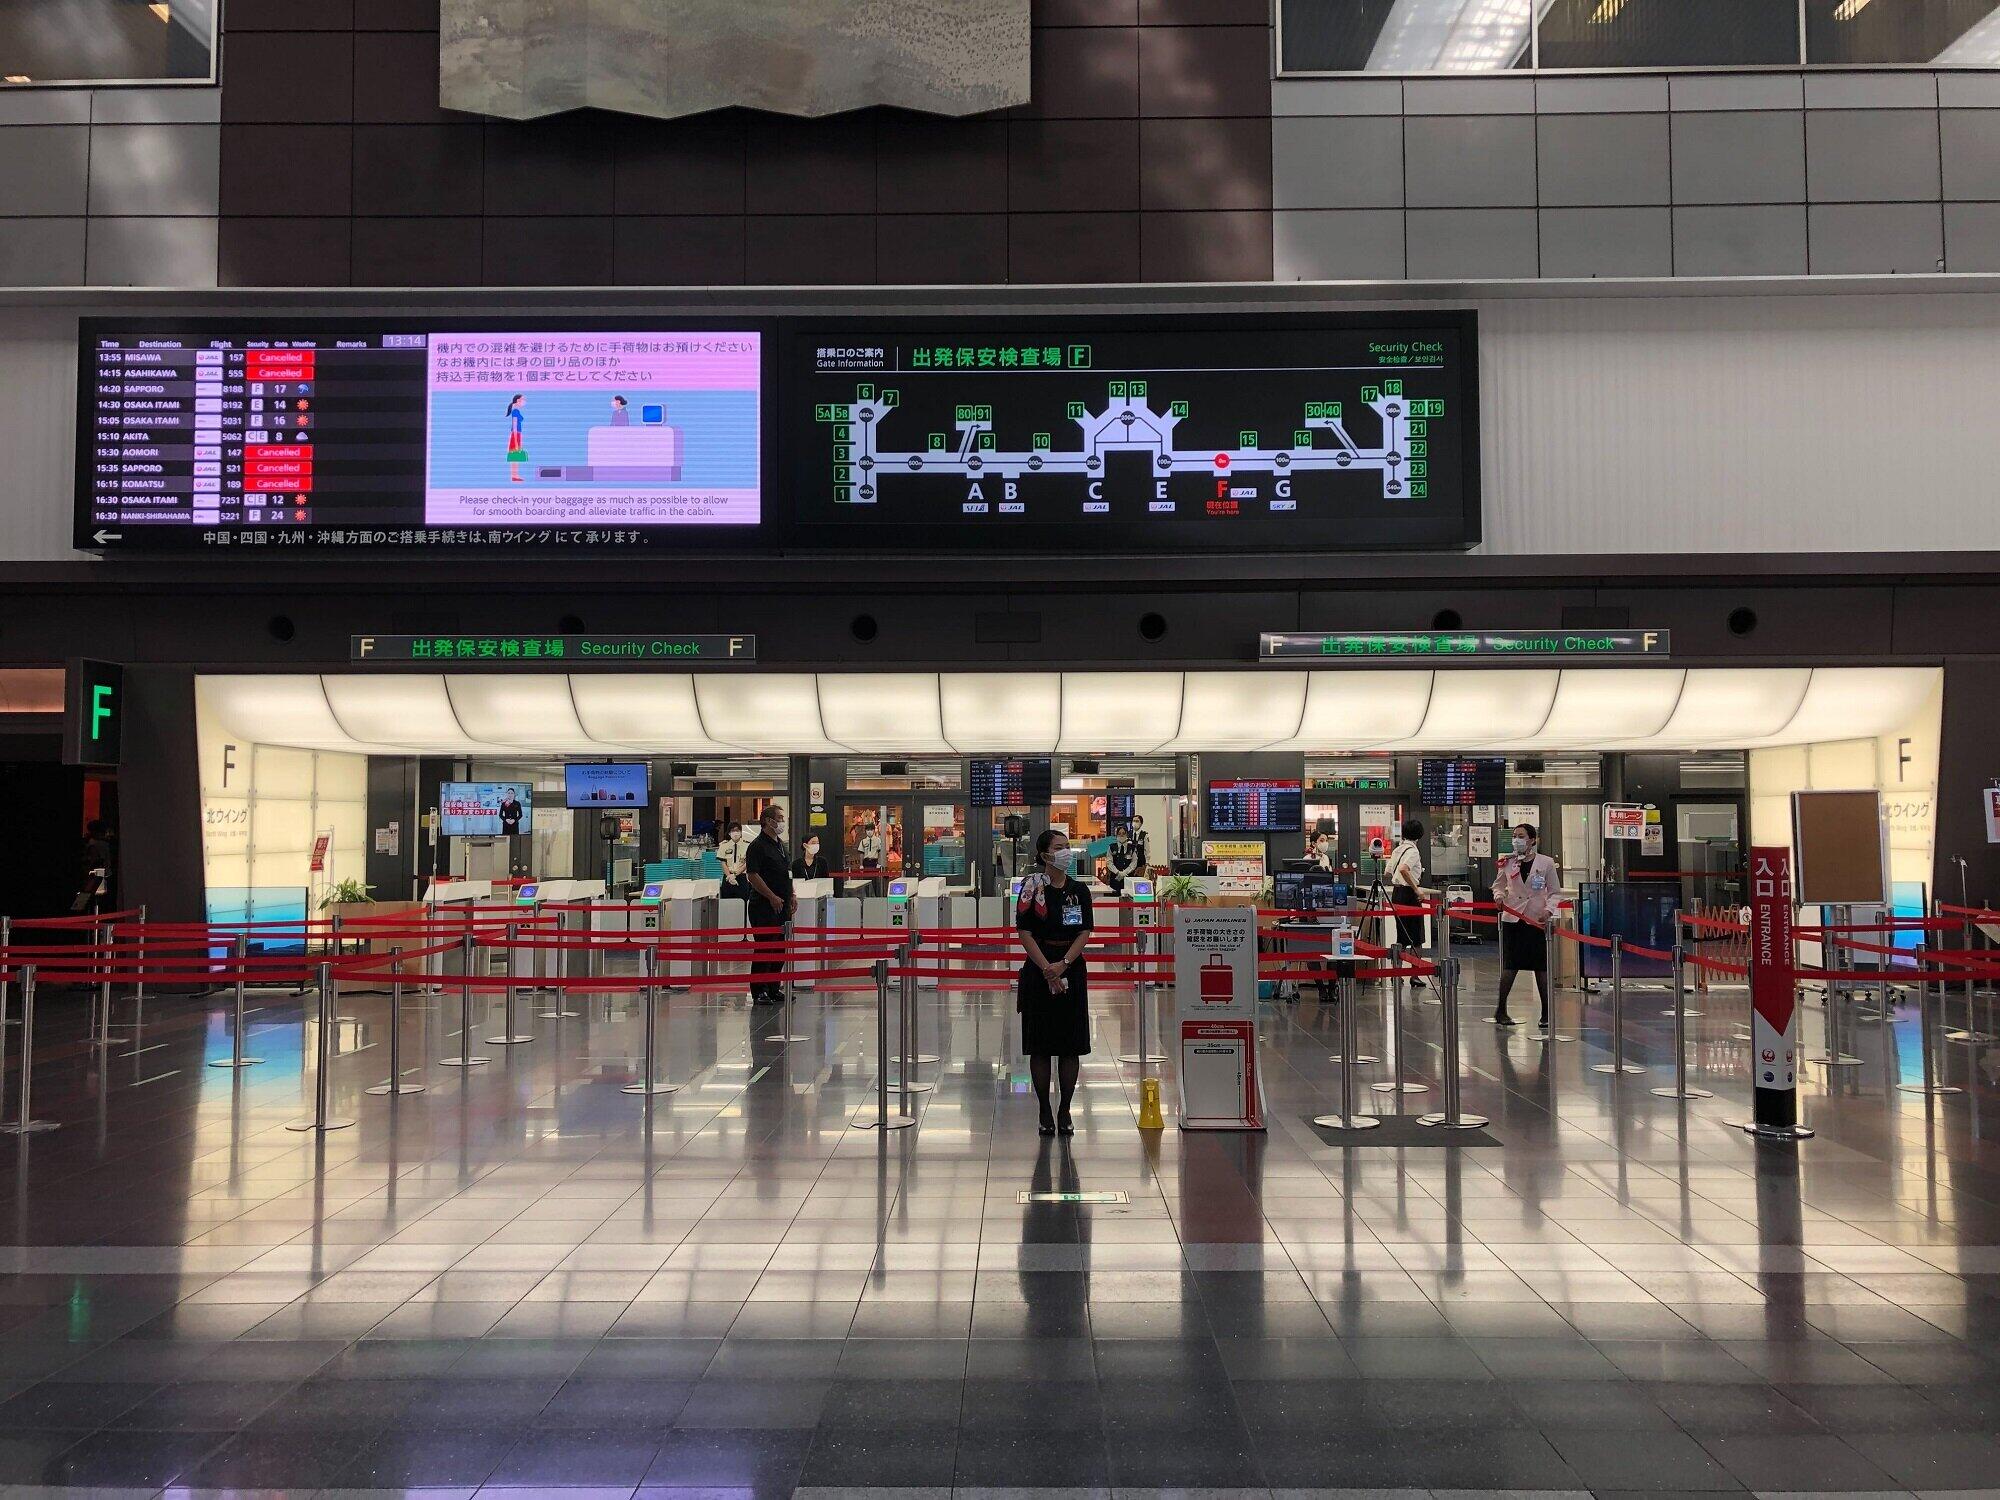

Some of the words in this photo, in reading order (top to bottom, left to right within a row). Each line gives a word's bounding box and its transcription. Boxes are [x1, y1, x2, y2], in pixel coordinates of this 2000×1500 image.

[210, 340, 232, 350] Flight
[247, 340, 270, 349] Security
[336, 340, 367, 348] Remarks
[388, 336, 421, 346] 13:14
[436, 342, 753, 354] 機内での混雑を避けるために手荷物はお預けください
[1368, 342, 1408, 354] Security
[1412, 341, 1443, 352] Check
[99, 354, 121, 362] 13:55
[124, 354, 161, 362] MISAWA
[229, 354, 244, 362] 157
[259, 353, 303, 362] Cancelled
[816, 347, 884, 358] 搭乗口のご案内
[912, 347, 1062, 367] 出発保安検査場
[1074, 348, 1085, 364] F
[436, 356, 621, 368] なお機内には身の回り品のほか
[816, 359, 836, 368] Gate
[838, 358, 884, 368] Information
[99, 370, 121, 378] 14:15
[124, 370, 177, 378] ASAHIKAWA
[228, 370, 244, 378] 555
[258, 369, 302, 378] Cancelled
[436, 370, 653, 382] 持込手荷物を1個までとしてください
[274, 385, 287, 394] 17
[1112, 384, 1124, 396] 12
[1132, 384, 1144, 396] 13
[1387, 383, 1400, 393] 18
[1364, 390, 1376, 400] 17
[223, 401, 243, 409] 8192
[274, 400, 287, 409] 14
[1174, 404, 1186, 414] 14
[1307, 405, 1320, 416] 30
[1326, 405, 1340, 416] 40
[1411, 403, 1424, 413] 20
[1429, 402, 1442, 413] 19
[818, 408, 830, 418] 5A
[836, 408, 848, 418] 5B
[958, 408, 971, 420] 80
[977, 408, 990, 420] 91
[1070, 406, 1082, 416] 11
[222, 417, 242, 425] 5031
[274, 416, 286, 425] 16
[1412, 424, 1424, 434] 21
[222, 433, 242, 441] 5062
[1035, 436, 1048, 447] 10
[1242, 434, 1254, 445] 15
[1296, 434, 1310, 445] 16
[97, 448, 119, 456] 15:30
[122, 448, 158, 456] AOMORI
[227, 449, 242, 457] 147
[258, 448, 300, 457] Cancelled
[1412, 444, 1424, 454] 22
[122, 464, 162, 472] SAPPORO
[226, 464, 241, 472] 521
[257, 464, 300, 472] Cancelled
[1412, 464, 1424, 474] 23
[256, 480, 300, 488] Cancelled
[1156, 481, 1168, 499] E
[1217, 480, 1228, 498] F
[1276, 480, 1291, 498] G
[1412, 484, 1425, 495] 24
[968, 482, 984, 500] A
[1004, 482, 1018, 500] B
[1088, 482, 1103, 500] C
[96, 496, 118, 504] 16:30
[221, 496, 240, 504] 7251
[272, 496, 284, 504] 12
[459, 495, 488, 504] Please
[491, 495, 529, 504] check-in
[531, 498, 552, 506] your
[554, 495, 594, 506] baggage
[609, 495, 634, 504] much
[650, 495, 688, 506] possible
[703, 495, 728, 504] allow
[96, 512, 118, 520] 16:30
[272, 512, 284, 520] 24
[473, 506, 486, 516] for
[488, 506, 522, 516] smooth
[525, 506, 566, 518] boarding
[568, 506, 586, 516] and
[588, 506, 627, 516] alleviate
[630, 506, 656, 516] traffic
[669, 506, 684, 516] the
[687, 506, 714, 516] cabin.
[360, 638, 375, 658] F
[412, 638, 564, 658] 出発保安検査場
[729, 638, 744, 657] F
[1270, 636, 1284, 654] F
[1322, 634, 1476, 654] 出発保安検査場
[1494, 636, 1558, 652] Security
[1564, 636, 1614, 650] Check
[1644, 632, 1658, 652] F
[582, 641, 646, 658] Security
[651, 641, 700, 655] Check
[92, 684, 112, 740] F
[223, 744, 236, 788] F
[1898, 738, 1912, 782] F
[206, 808, 248, 824] 北ウイング
[1756, 858, 1774, 898] 入口
[1760, 904, 1772, 966] ENTRANCE
